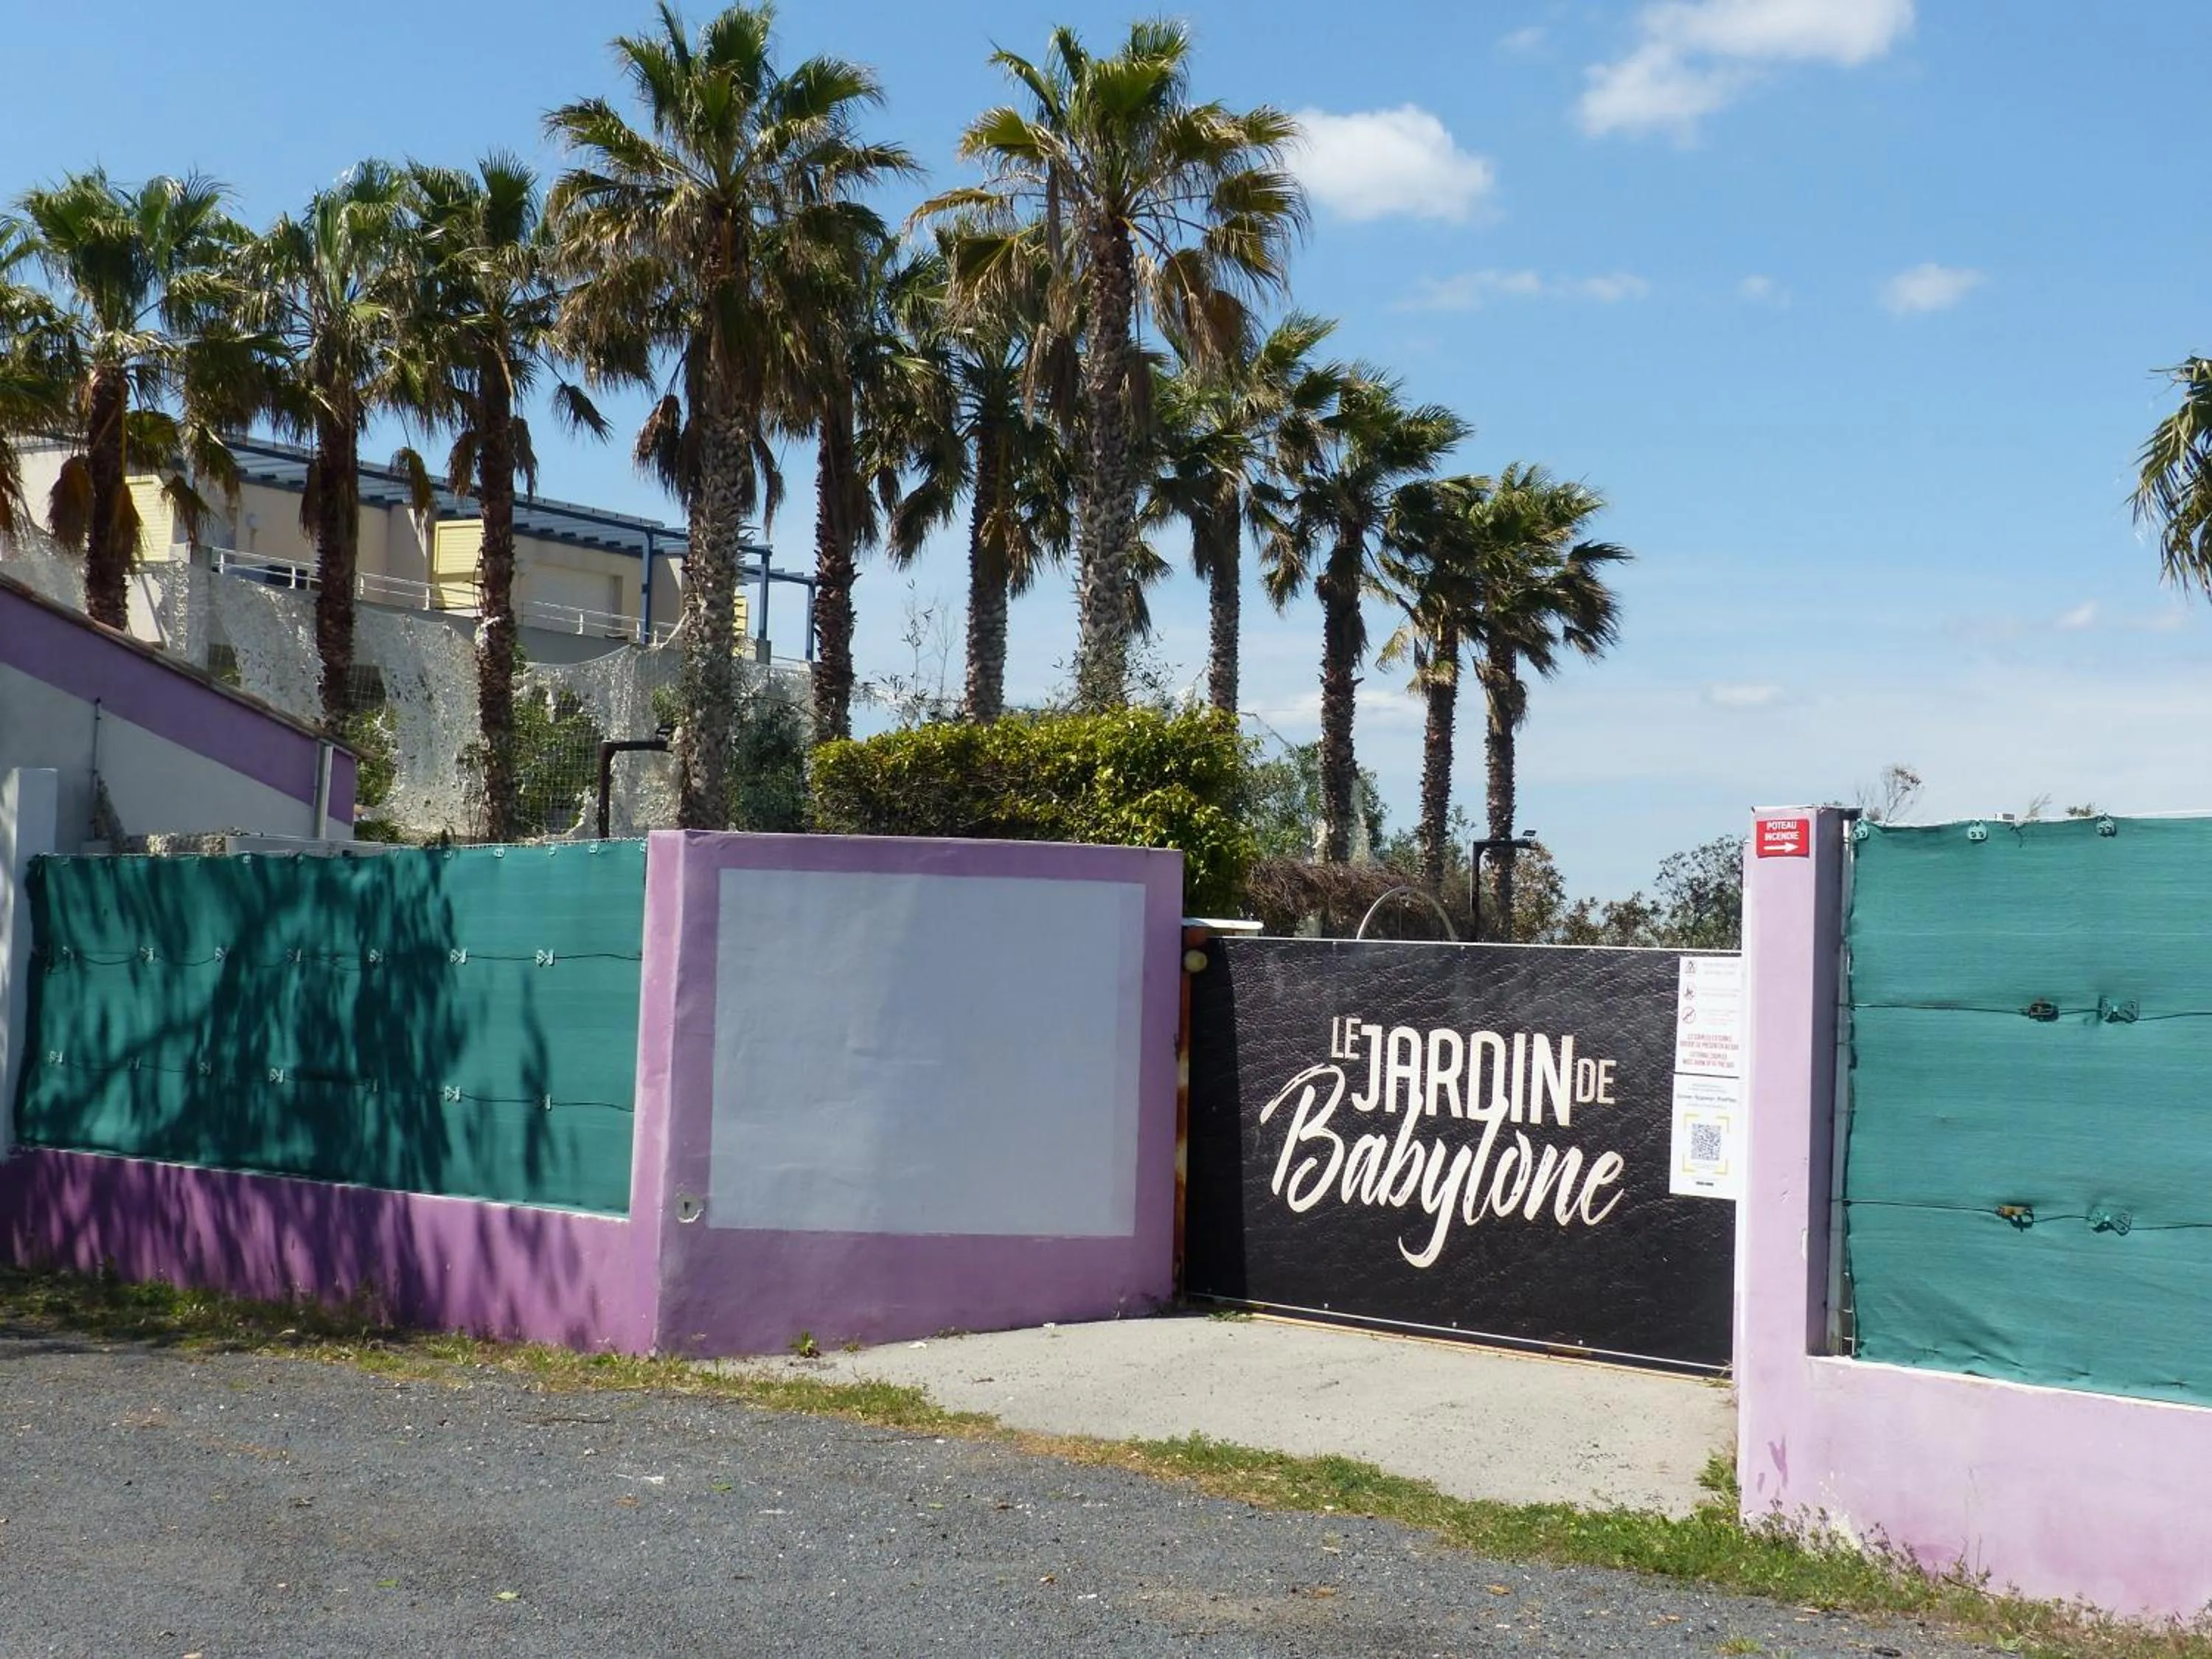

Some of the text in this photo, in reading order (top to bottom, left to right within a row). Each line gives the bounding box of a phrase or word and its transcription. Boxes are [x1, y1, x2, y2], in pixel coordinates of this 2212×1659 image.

[1764, 831, 1800, 841] INCENDIE
[1766, 821, 1797, 831] POTEAU
[1330, 1017, 1618, 1126] LE JARDIN DE
[1259, 1062, 1624, 1268] Babylone
